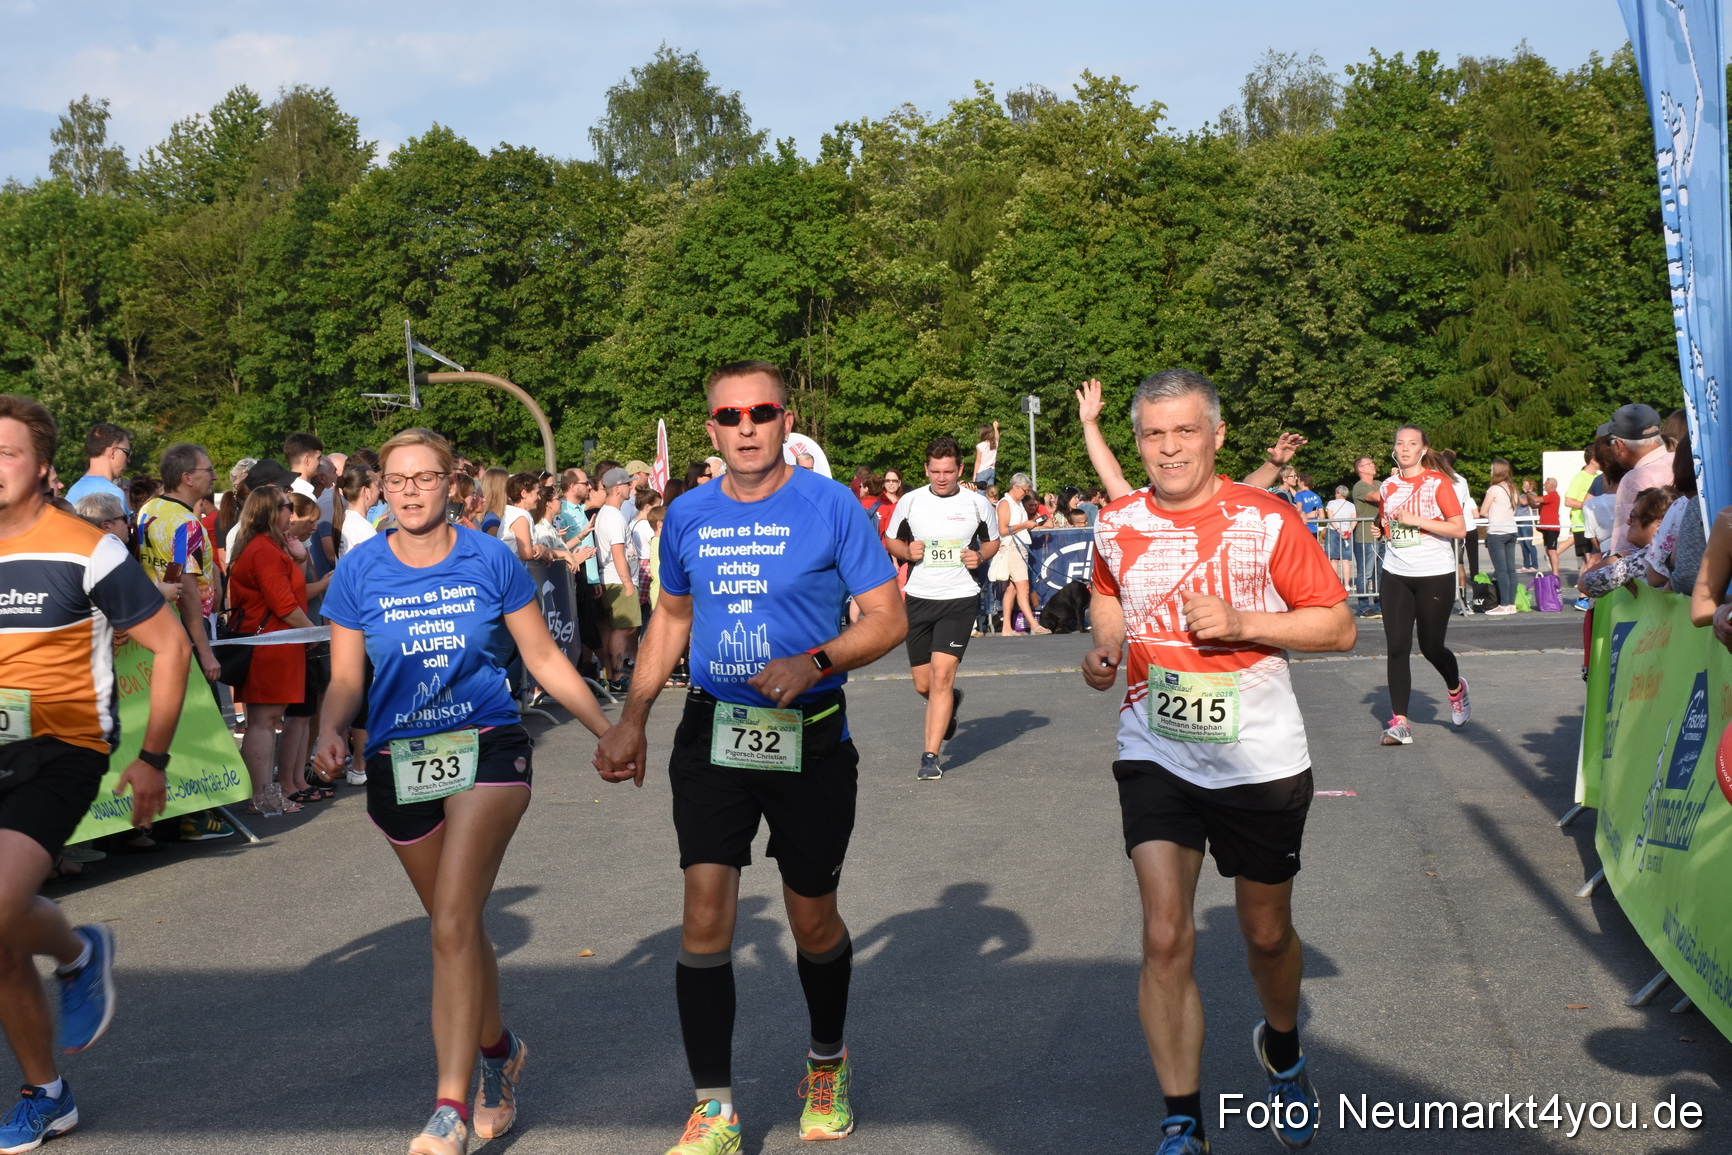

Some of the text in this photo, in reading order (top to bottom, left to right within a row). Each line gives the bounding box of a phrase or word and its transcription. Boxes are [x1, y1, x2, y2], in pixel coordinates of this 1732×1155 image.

[698, 522, 790, 540] Wenn es beim
[1391, 529, 1414, 540] 2211
[698, 541, 786, 558] Hausverkauf
[931, 549, 953, 560] 961
[717, 561, 760, 577] richtig
[709, 580, 768, 595] LAUFEN
[379, 585, 477, 610] Wenn es beim
[384, 599, 476, 623] Hausverkauf
[727, 599, 753, 614] soll!
[408, 619, 455, 636] richtig
[401, 634, 466, 656] LAUFEN
[423, 654, 449, 669] soll!
[709, 660, 767, 676] FELDBUS
[1157, 692, 1226, 723] 2215
[1160, 717, 1222, 732] Hofmann Stephan
[731, 727, 781, 754] 732
[725, 749, 787, 761] Pigorsch Christian
[411, 755, 461, 783] 733
[407, 777, 467, 793] Pigorsch Christiane
